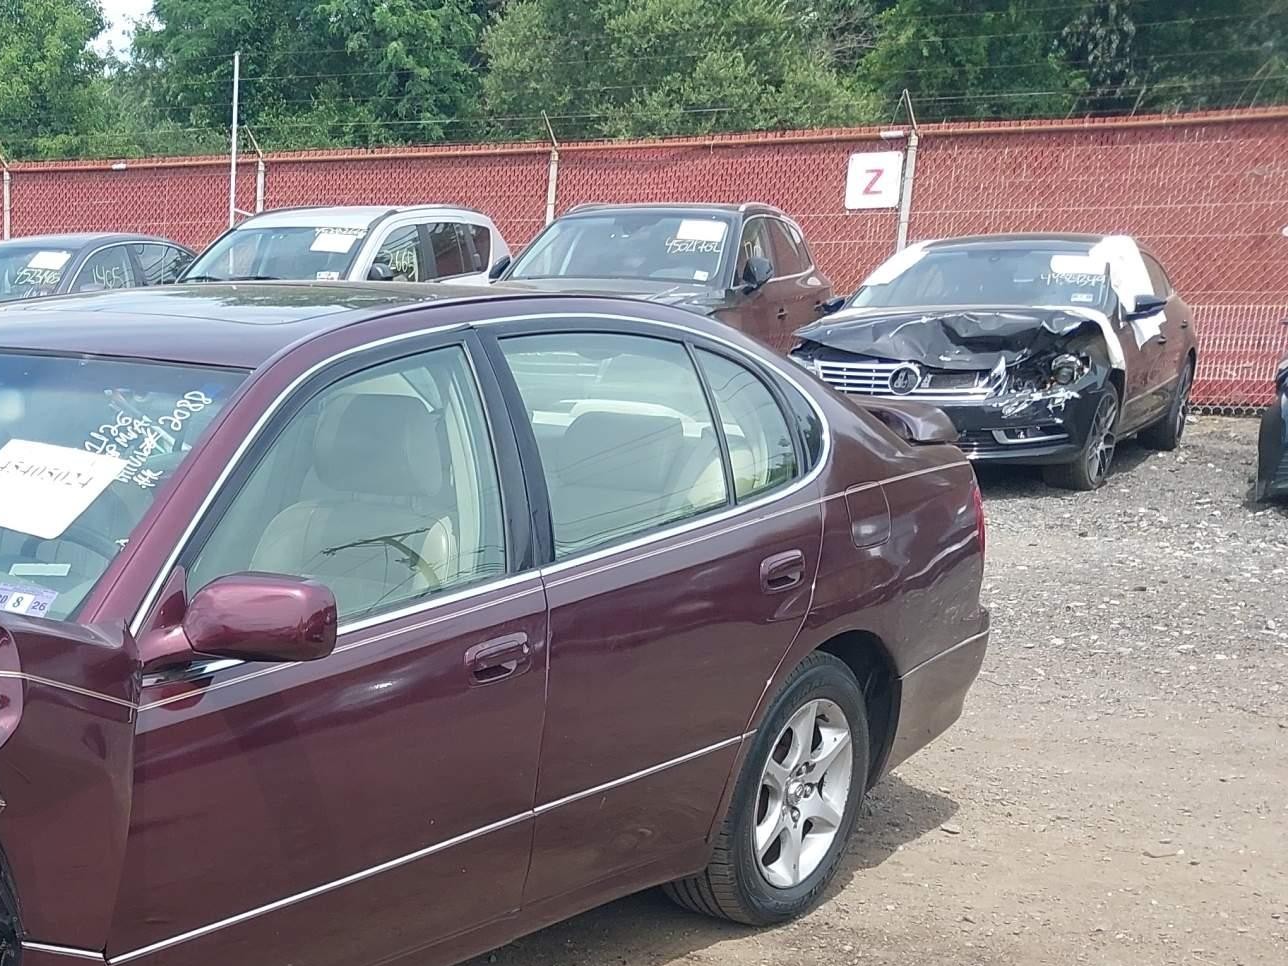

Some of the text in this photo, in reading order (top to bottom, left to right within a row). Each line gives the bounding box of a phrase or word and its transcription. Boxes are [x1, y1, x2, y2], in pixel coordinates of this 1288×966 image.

[863, 168, 884, 195] Z
[12, 596, 24, 608] 8
[32, 600, 48, 611] 26
